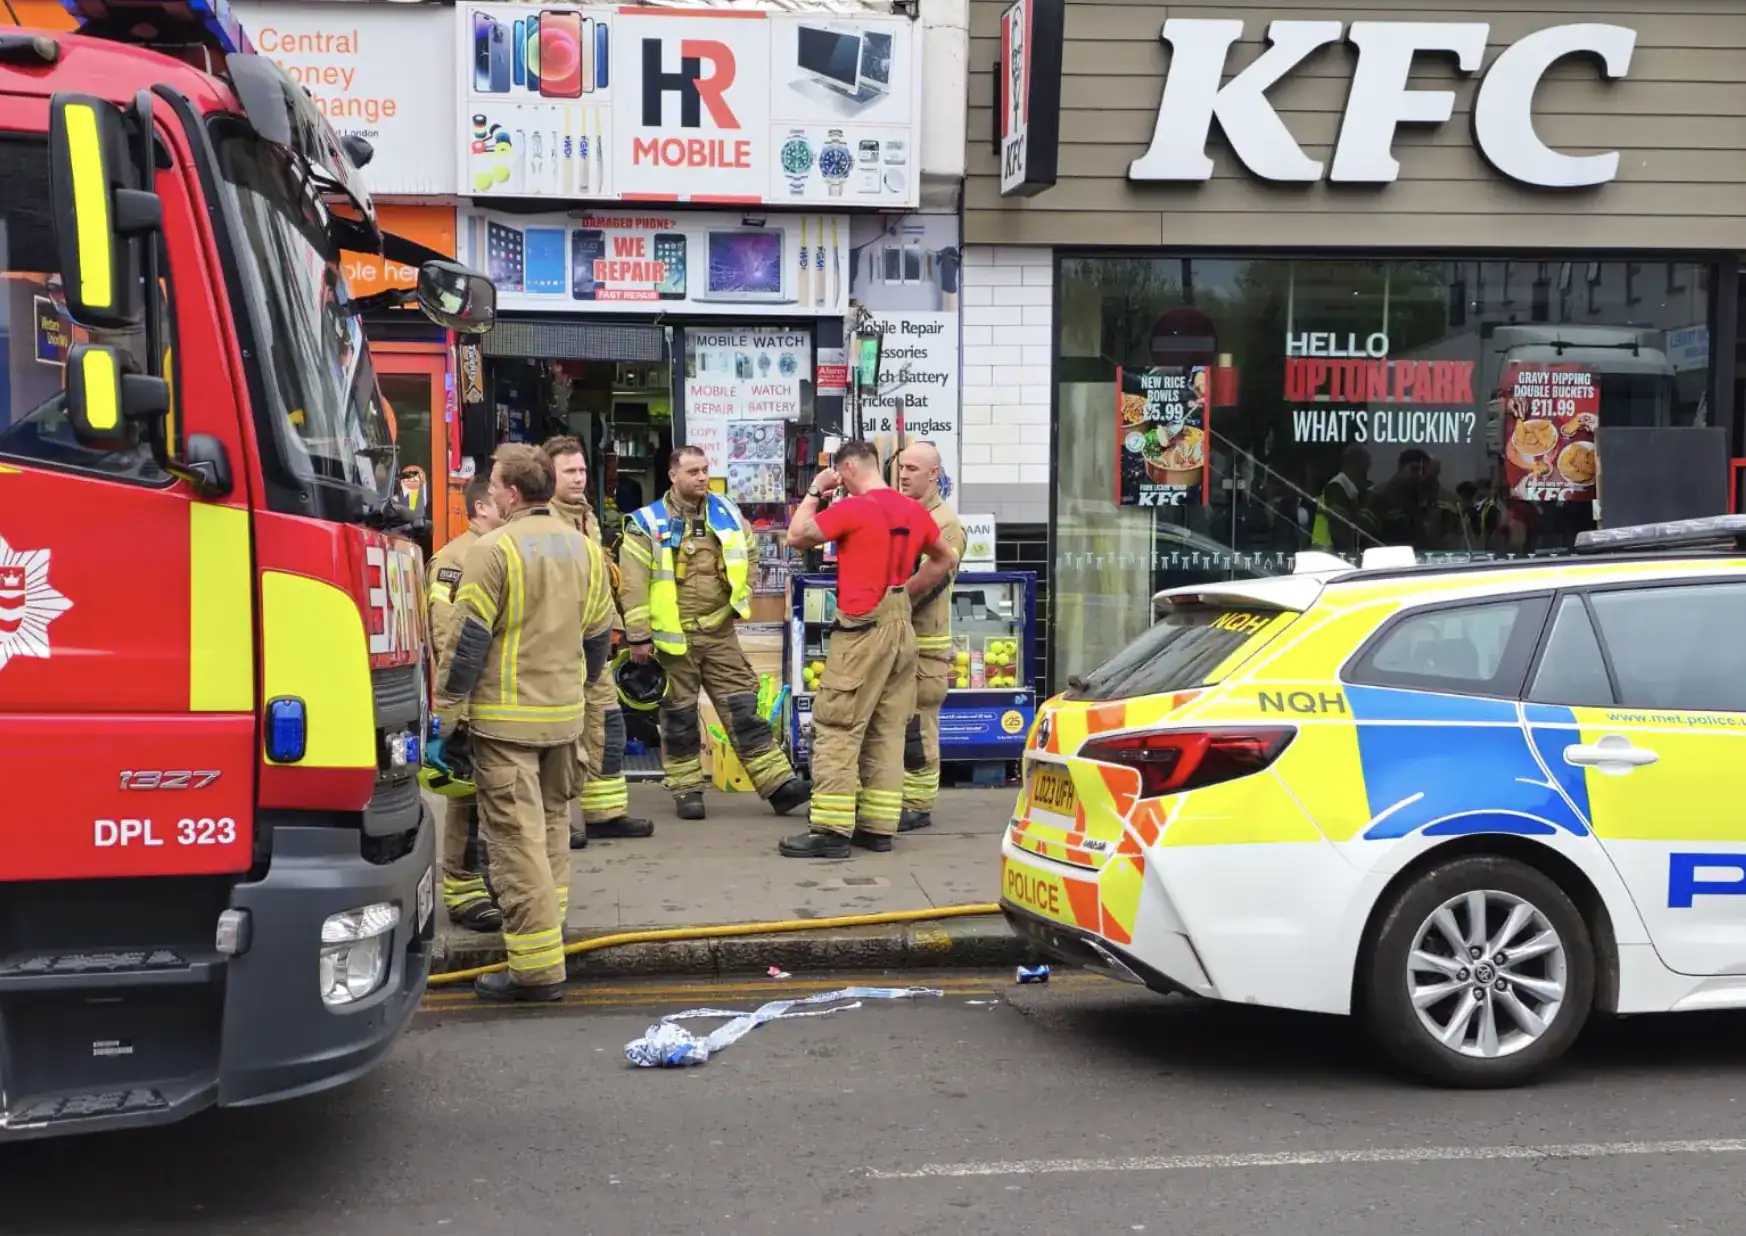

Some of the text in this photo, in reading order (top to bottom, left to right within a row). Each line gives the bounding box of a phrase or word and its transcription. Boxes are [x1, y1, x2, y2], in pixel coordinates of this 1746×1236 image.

[259, 27, 358, 53] Central
[276, 60, 355, 91] oney
[642, 38, 741, 129] HR
[312, 93, 397, 123] hange
[1128, 18, 1637, 187] KFC
[632, 137, 751, 169] MOBILE
[1004, 134, 1024, 180] KFC
[581, 216, 633, 229] DAMAGED
[613, 236, 645, 257] WE
[594, 260, 665, 282] REPAIR
[901, 320, 945, 338] Repair
[697, 335, 805, 348] MOBILE WATCH
[1287, 332, 1389, 357] HELLO
[879, 345, 928, 359] essories
[899, 369, 949, 387] Battery
[1141, 374, 1186, 389] NEW RICE
[1284, 359, 1476, 404] UPTON PARK
[1518, 372, 1592, 385] GRAVY DIPPING
[690, 386, 737, 398] MOBILE
[751, 385, 792, 396] WATCH
[1147, 390, 1180, 402] BOWLS
[1514, 385, 1595, 399] DOUBLE BUCKETS
[694, 404, 734, 415] REPAIR
[748, 402, 796, 413] BATTERY
[862, 394, 929, 408] ricke Bat
[1531, 399, 1576, 417] £11.99
[1143, 403, 1184, 421] £5.99
[862, 417, 952, 435] all & unglass
[1293, 411, 1476, 443] WHAT'S CLUCKIN'?
[1138, 491, 1188, 506] KFC
[966, 525, 990, 535] AAN
[1208, 611, 1271, 635] NQH
[1258, 691, 1347, 714] NQH
[119, 770, 221, 790] 1327
[95, 817, 237, 846] DPL 323
[1667, 852, 1746, 908] P
[1008, 869, 1060, 914] POLICE
